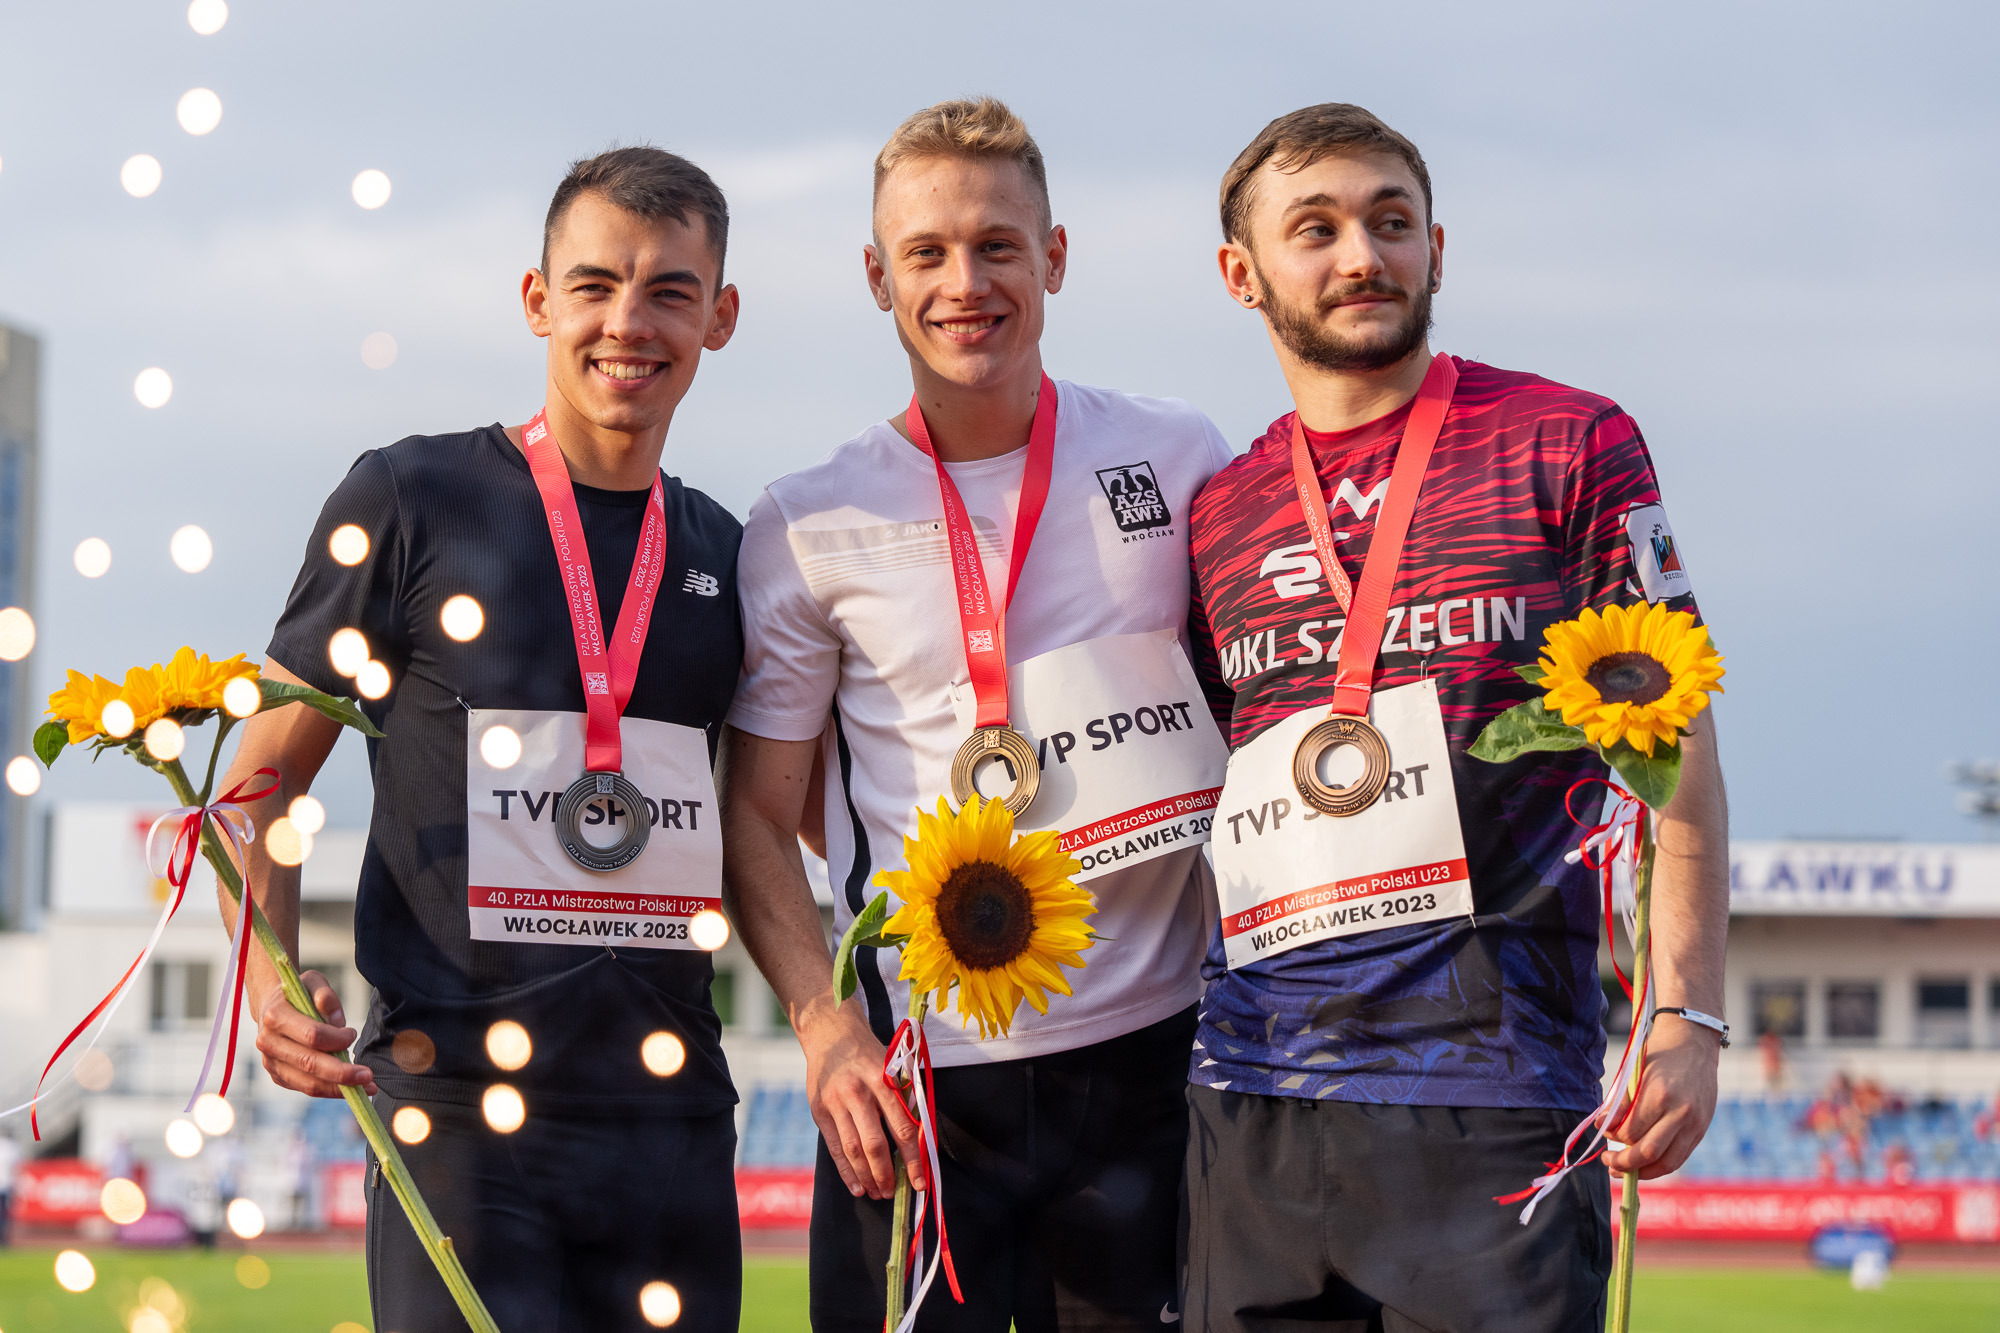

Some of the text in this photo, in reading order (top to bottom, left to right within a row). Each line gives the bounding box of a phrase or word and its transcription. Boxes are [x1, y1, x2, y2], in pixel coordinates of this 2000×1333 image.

[1115, 490, 1159, 511] AZS
[1121, 504, 1163, 526] AWF
[902, 522, 941, 537] JAKO
[1122, 529, 1175, 543] WROCŁAW
[634, 566, 647, 588] 2023
[952, 527, 970, 590] MISTRZOSTWA
[962, 530, 986, 615] WŁOCŁAWEK 2023
[552, 510, 591, 656] PZLA MISTRZOSTWA POLSKI U23
[577, 564, 601, 656] WŁOCŁAWEK 2023
[636, 595, 650, 626] POLSKI
[963, 592, 974, 615] PZLA
[630, 626, 643, 644] U23
[1220, 596, 1525, 681] MKL SZZECIN
[1086, 702, 1194, 752] SPORT
[1059, 835, 1084, 852] ZLA
[1086, 805, 1174, 842] Mistrzostwa
[1175, 793, 1212, 812] Polski
[1227, 798, 1291, 845] TVP
[579, 856, 613, 869] Mistrzostwa
[1077, 823, 1187, 873] OCŁAWEK
[488, 891, 705, 914] 40. PZLA Mistrzostwa Polski U23
[1237, 866, 1451, 929] 40. PZLA Mistrzostwa Polski U23
[503, 916, 689, 940] WŁOCŁAWEK 2023
[1251, 893, 1437, 952] WŁOCŁAWEK 2023
